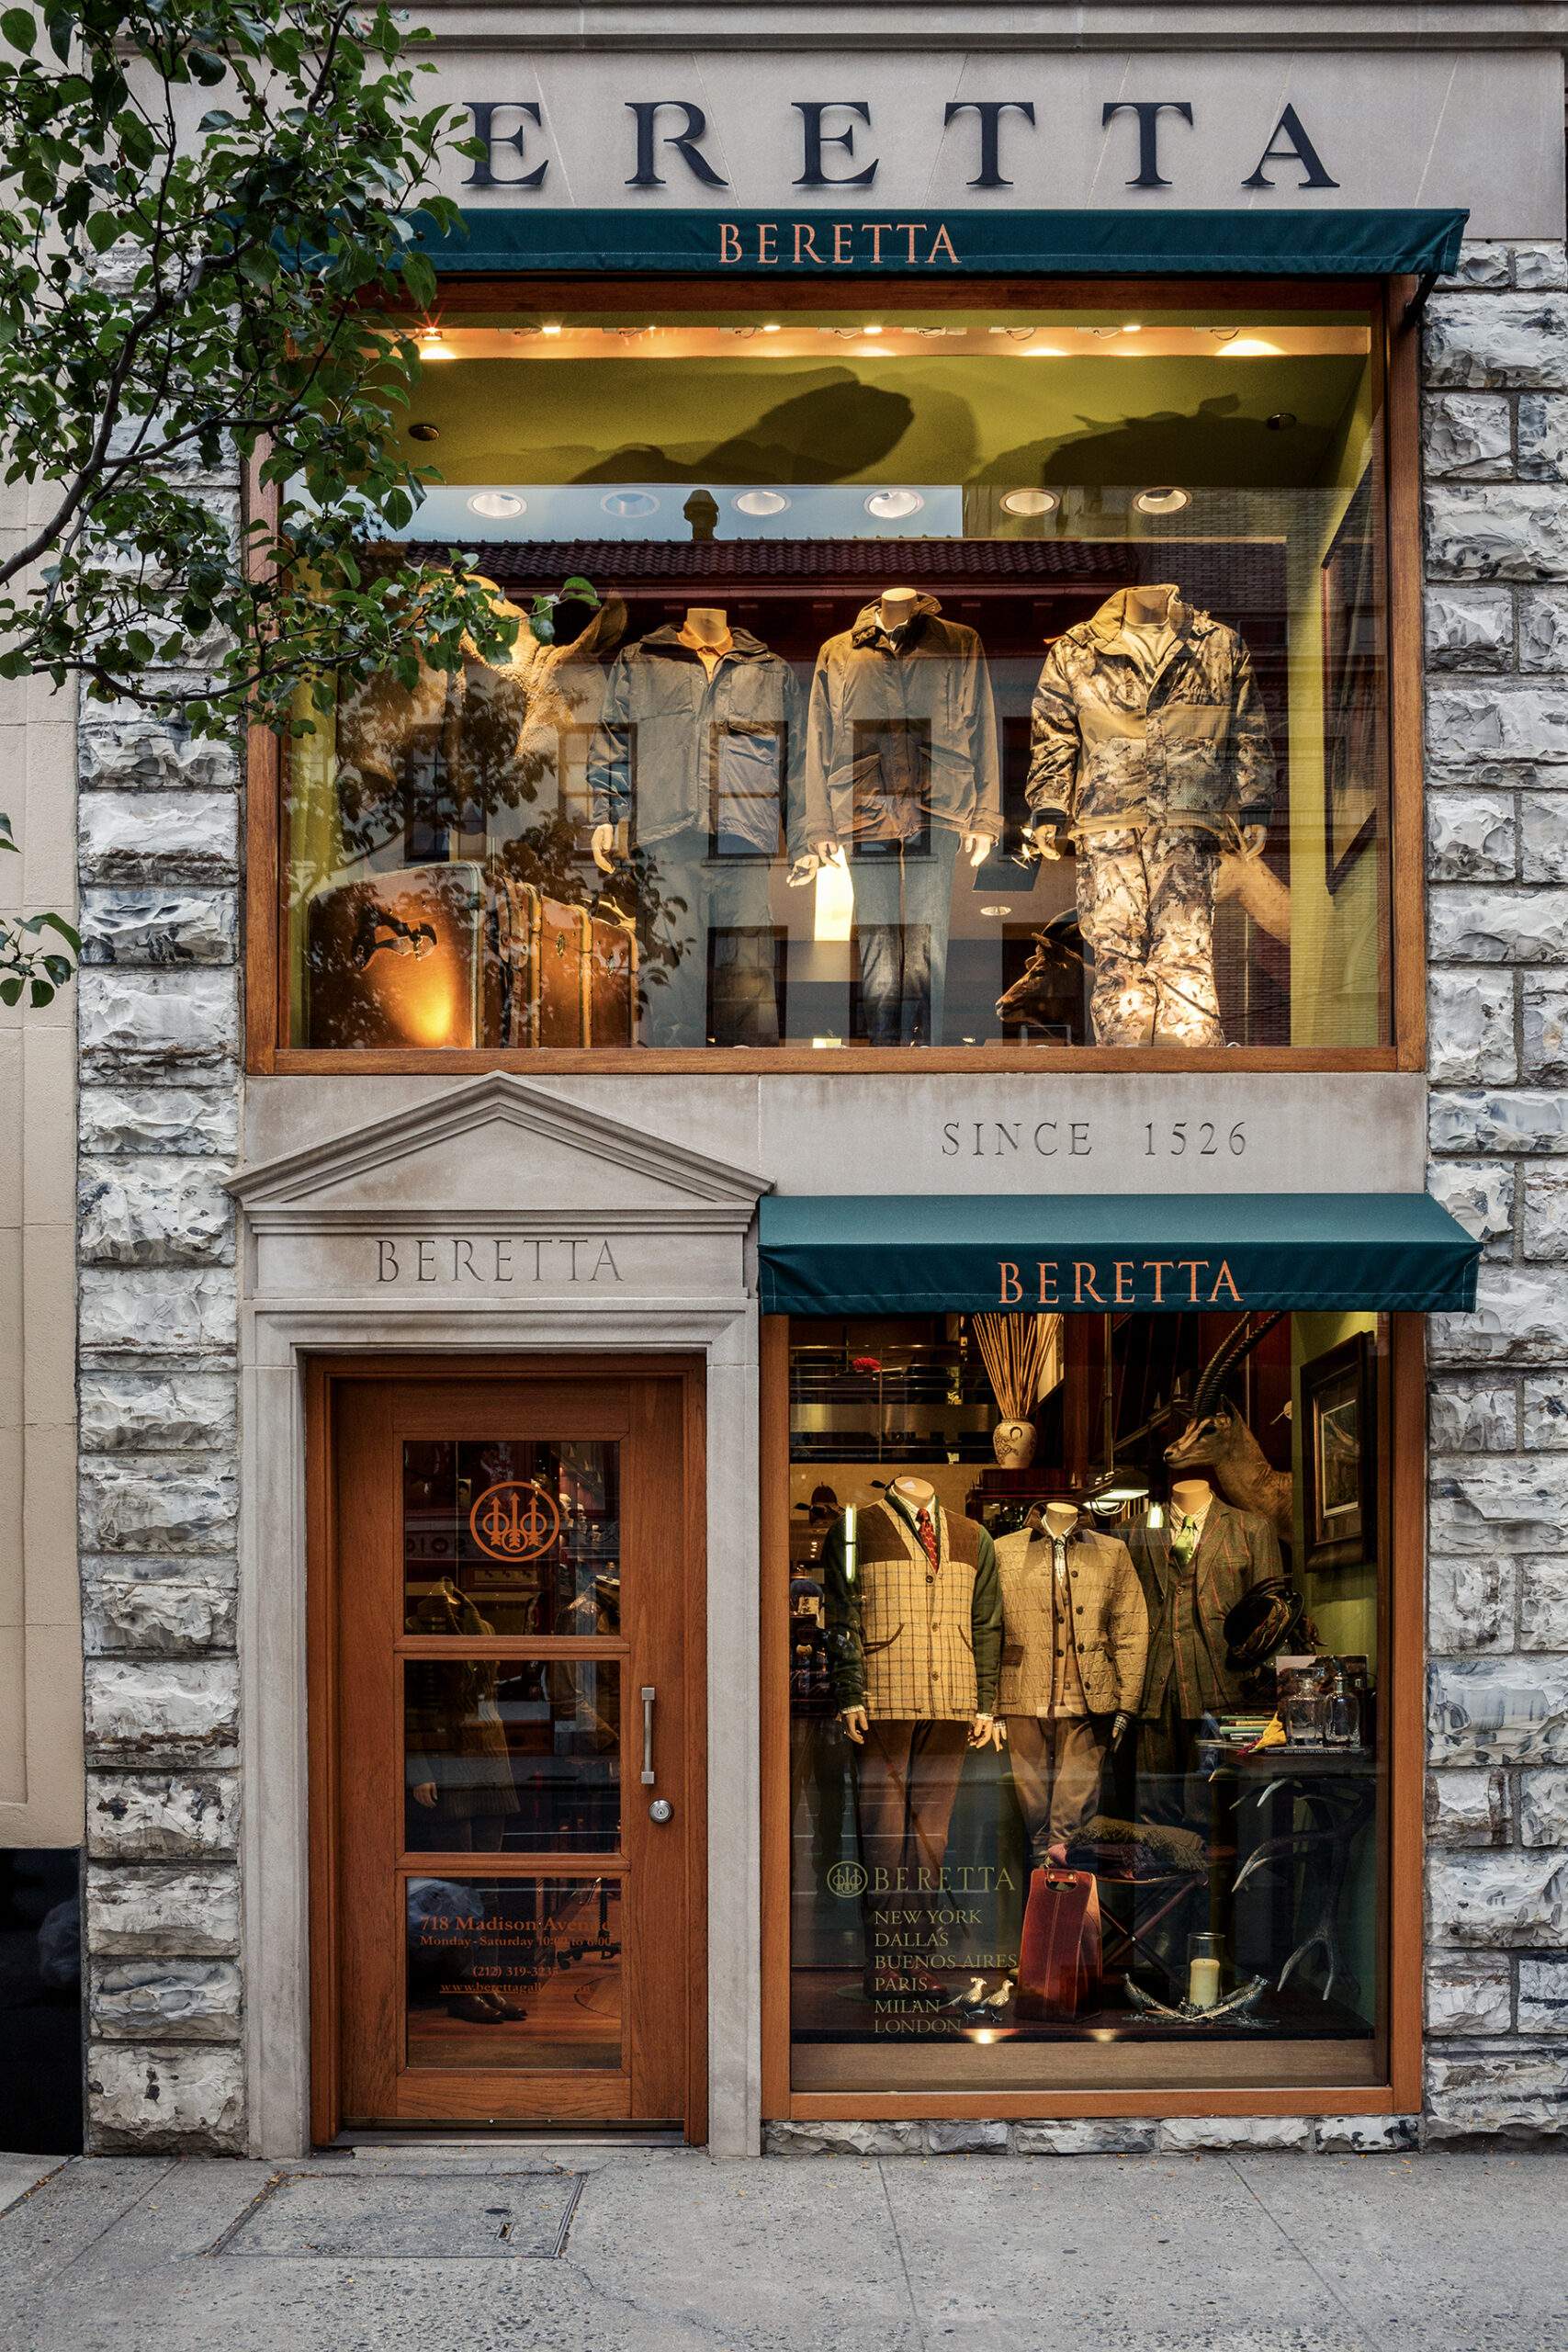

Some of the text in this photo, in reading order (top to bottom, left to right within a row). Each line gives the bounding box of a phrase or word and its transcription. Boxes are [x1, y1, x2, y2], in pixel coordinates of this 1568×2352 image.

[461, 101, 1340, 188] ERETTA
[717, 222, 963, 266] BERETTA
[942, 1122, 1247, 1156] SINCE 1526
[376, 1238, 625, 1283] BERETTA
[998, 1260, 1245, 1305] BERETTA
[874, 1866, 1015, 1891] BERETTA
[420, 1915, 450, 1930] 718
[456, 1914, 538, 1931] Madison
[874, 1909, 983, 1925] NEW YORK
[420, 1935, 473, 1947] Monday
[479, 1934, 534, 1947] Saturday
[874, 1932, 949, 1947] DALLAS
[874, 1954, 1018, 1970] BUENOS AIRES
[472, 1964, 502, 1978] (212)
[874, 1977, 928, 1992] PARIS
[874, 1999, 941, 2014] MILAN
[874, 2019, 962, 2034] LONDON
